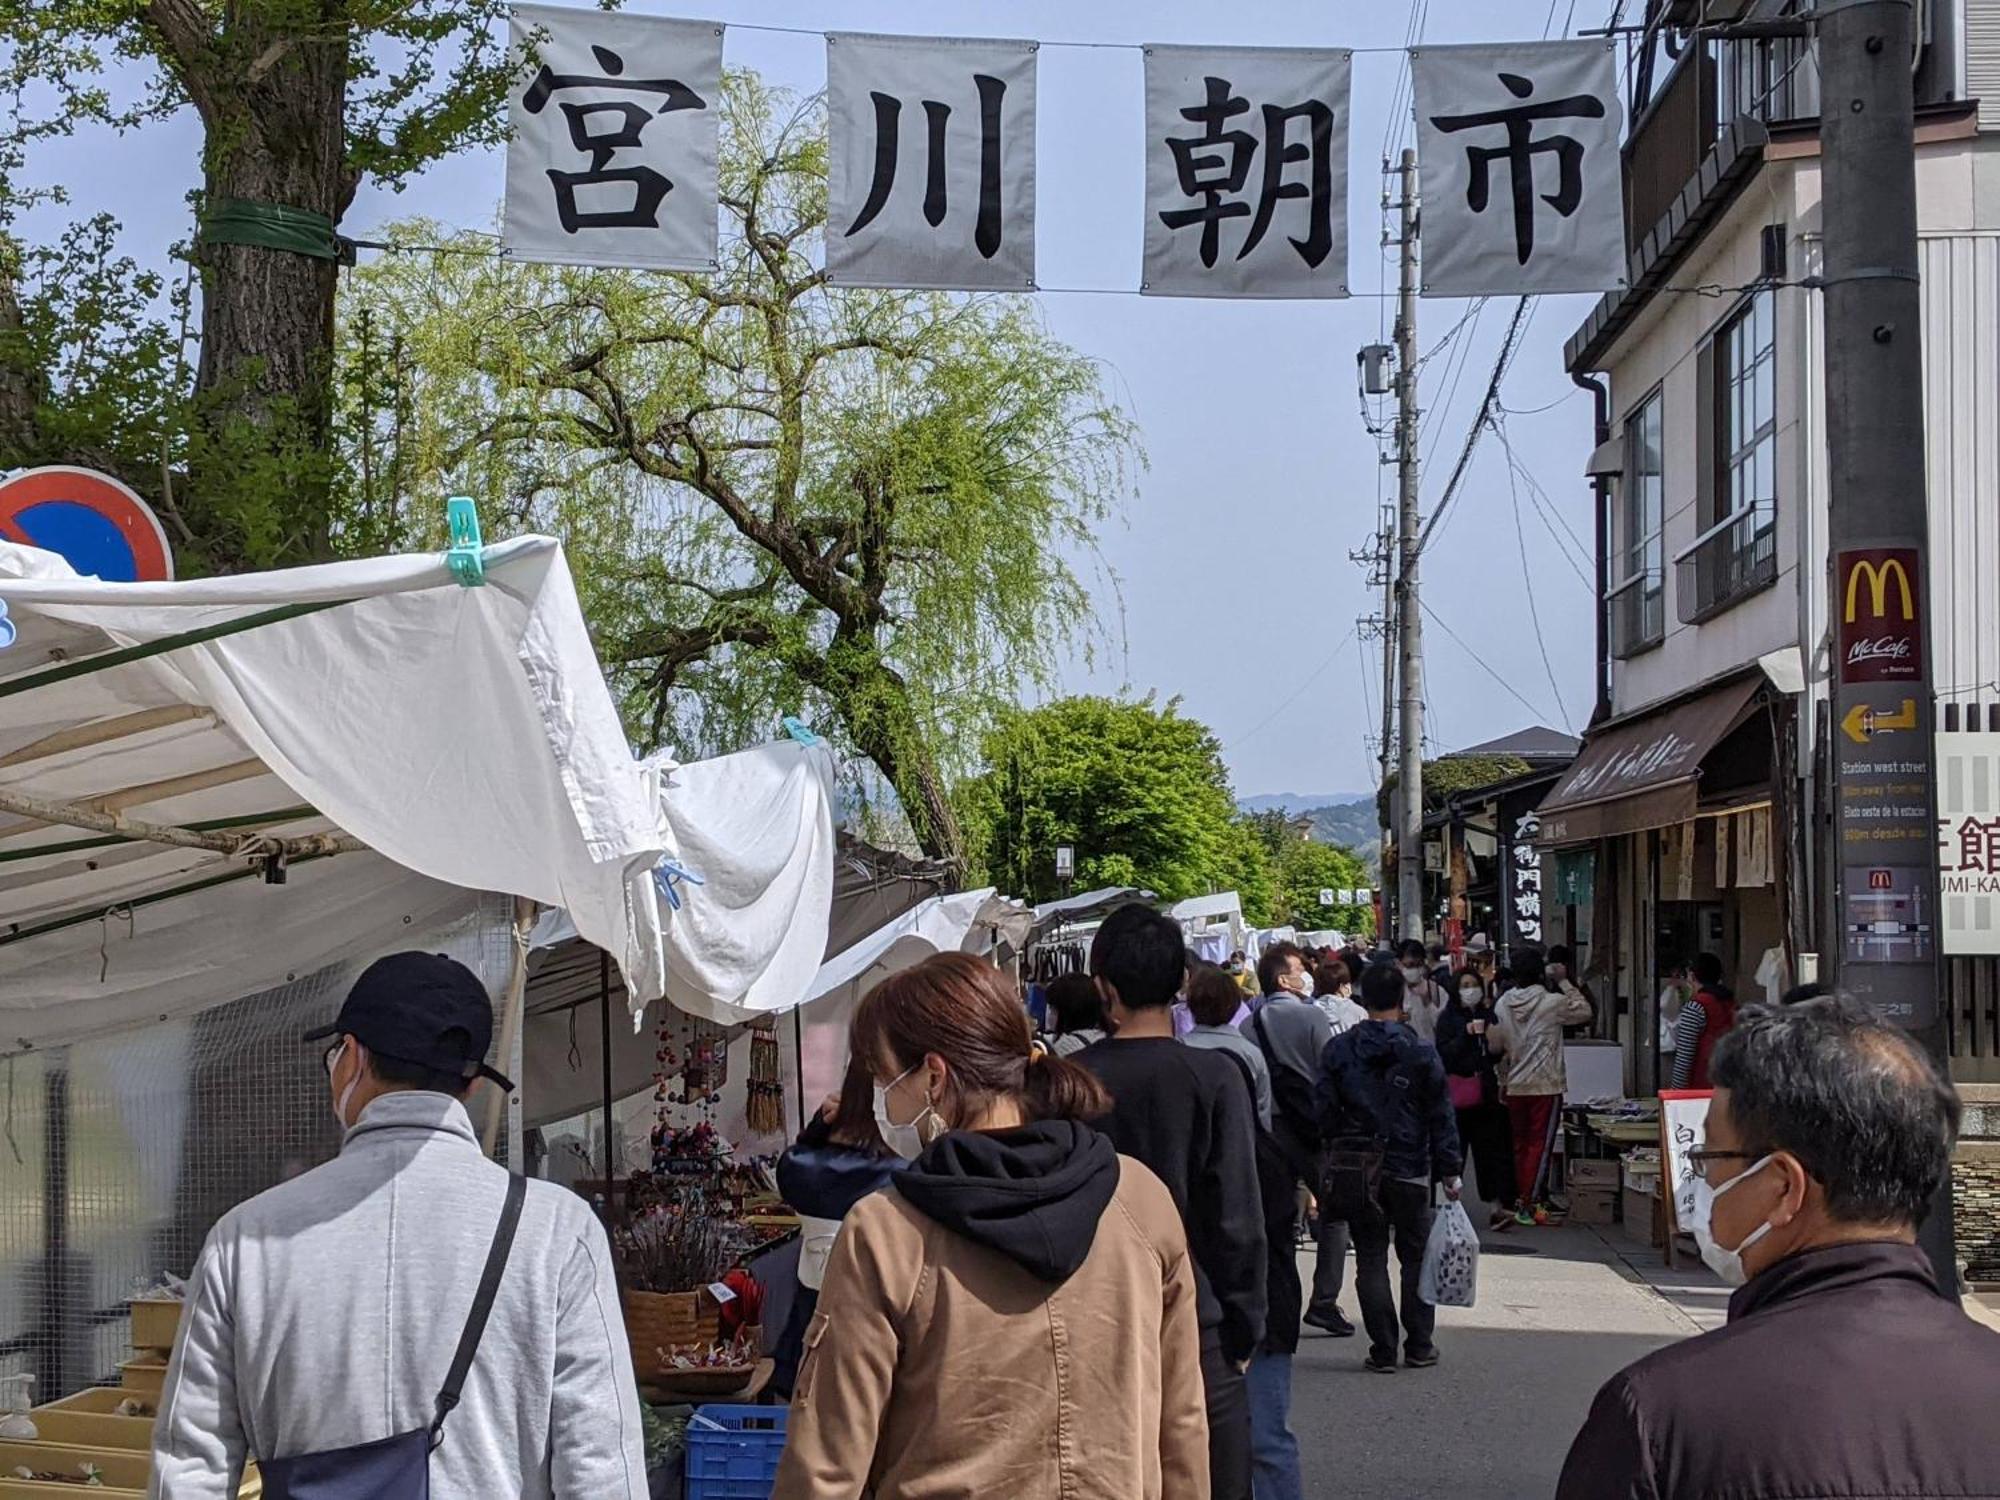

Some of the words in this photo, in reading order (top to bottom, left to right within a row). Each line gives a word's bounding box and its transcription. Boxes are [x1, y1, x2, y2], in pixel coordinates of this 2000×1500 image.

[1841, 761, 1872, 775] Station
[1874, 761, 1898, 773] west
[1900, 761, 1926, 773] street
